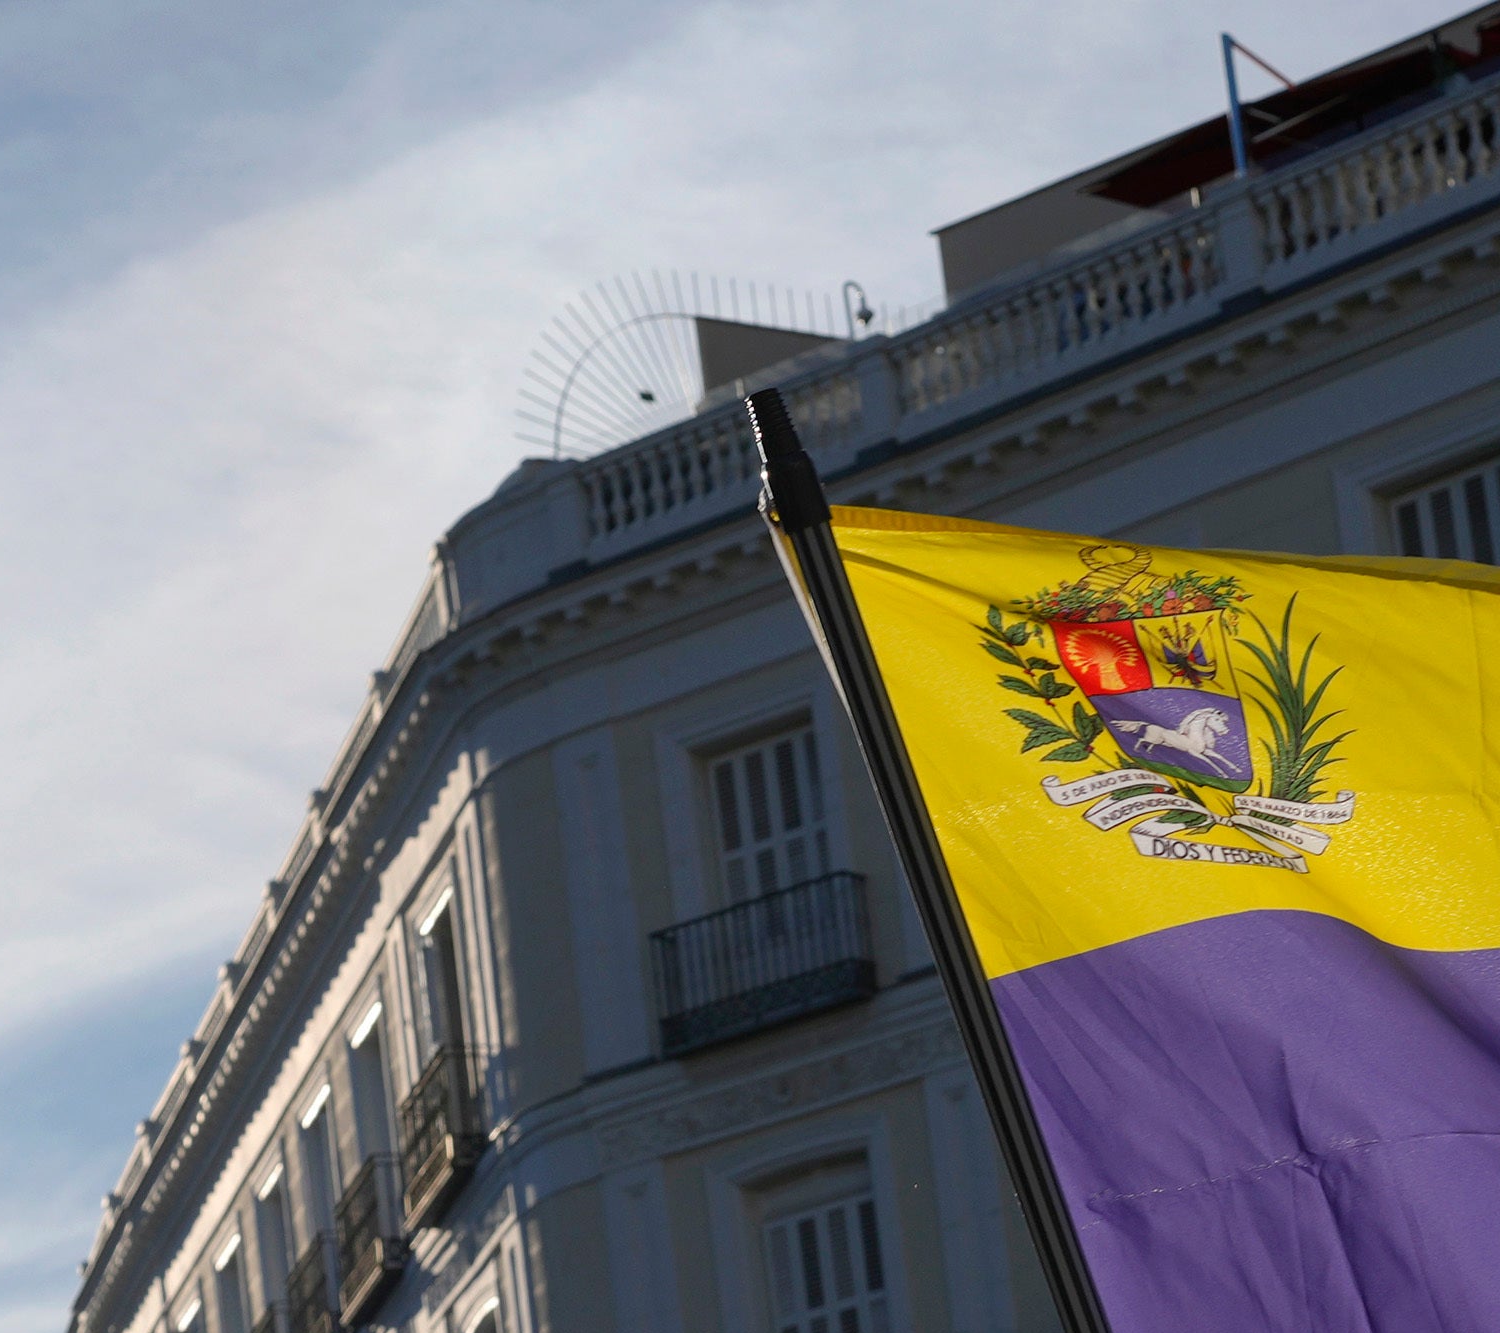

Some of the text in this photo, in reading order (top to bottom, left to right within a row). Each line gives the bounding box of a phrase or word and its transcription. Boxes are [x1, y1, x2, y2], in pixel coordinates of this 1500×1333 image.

[1072, 786, 1089, 799] DE
[1099, 797, 1195, 827] INDEPENDENCIA
[1246, 818, 1305, 846] LIBERTAD
[1151, 837, 1202, 862] DIOS
[1204, 842, 1217, 862] Y
